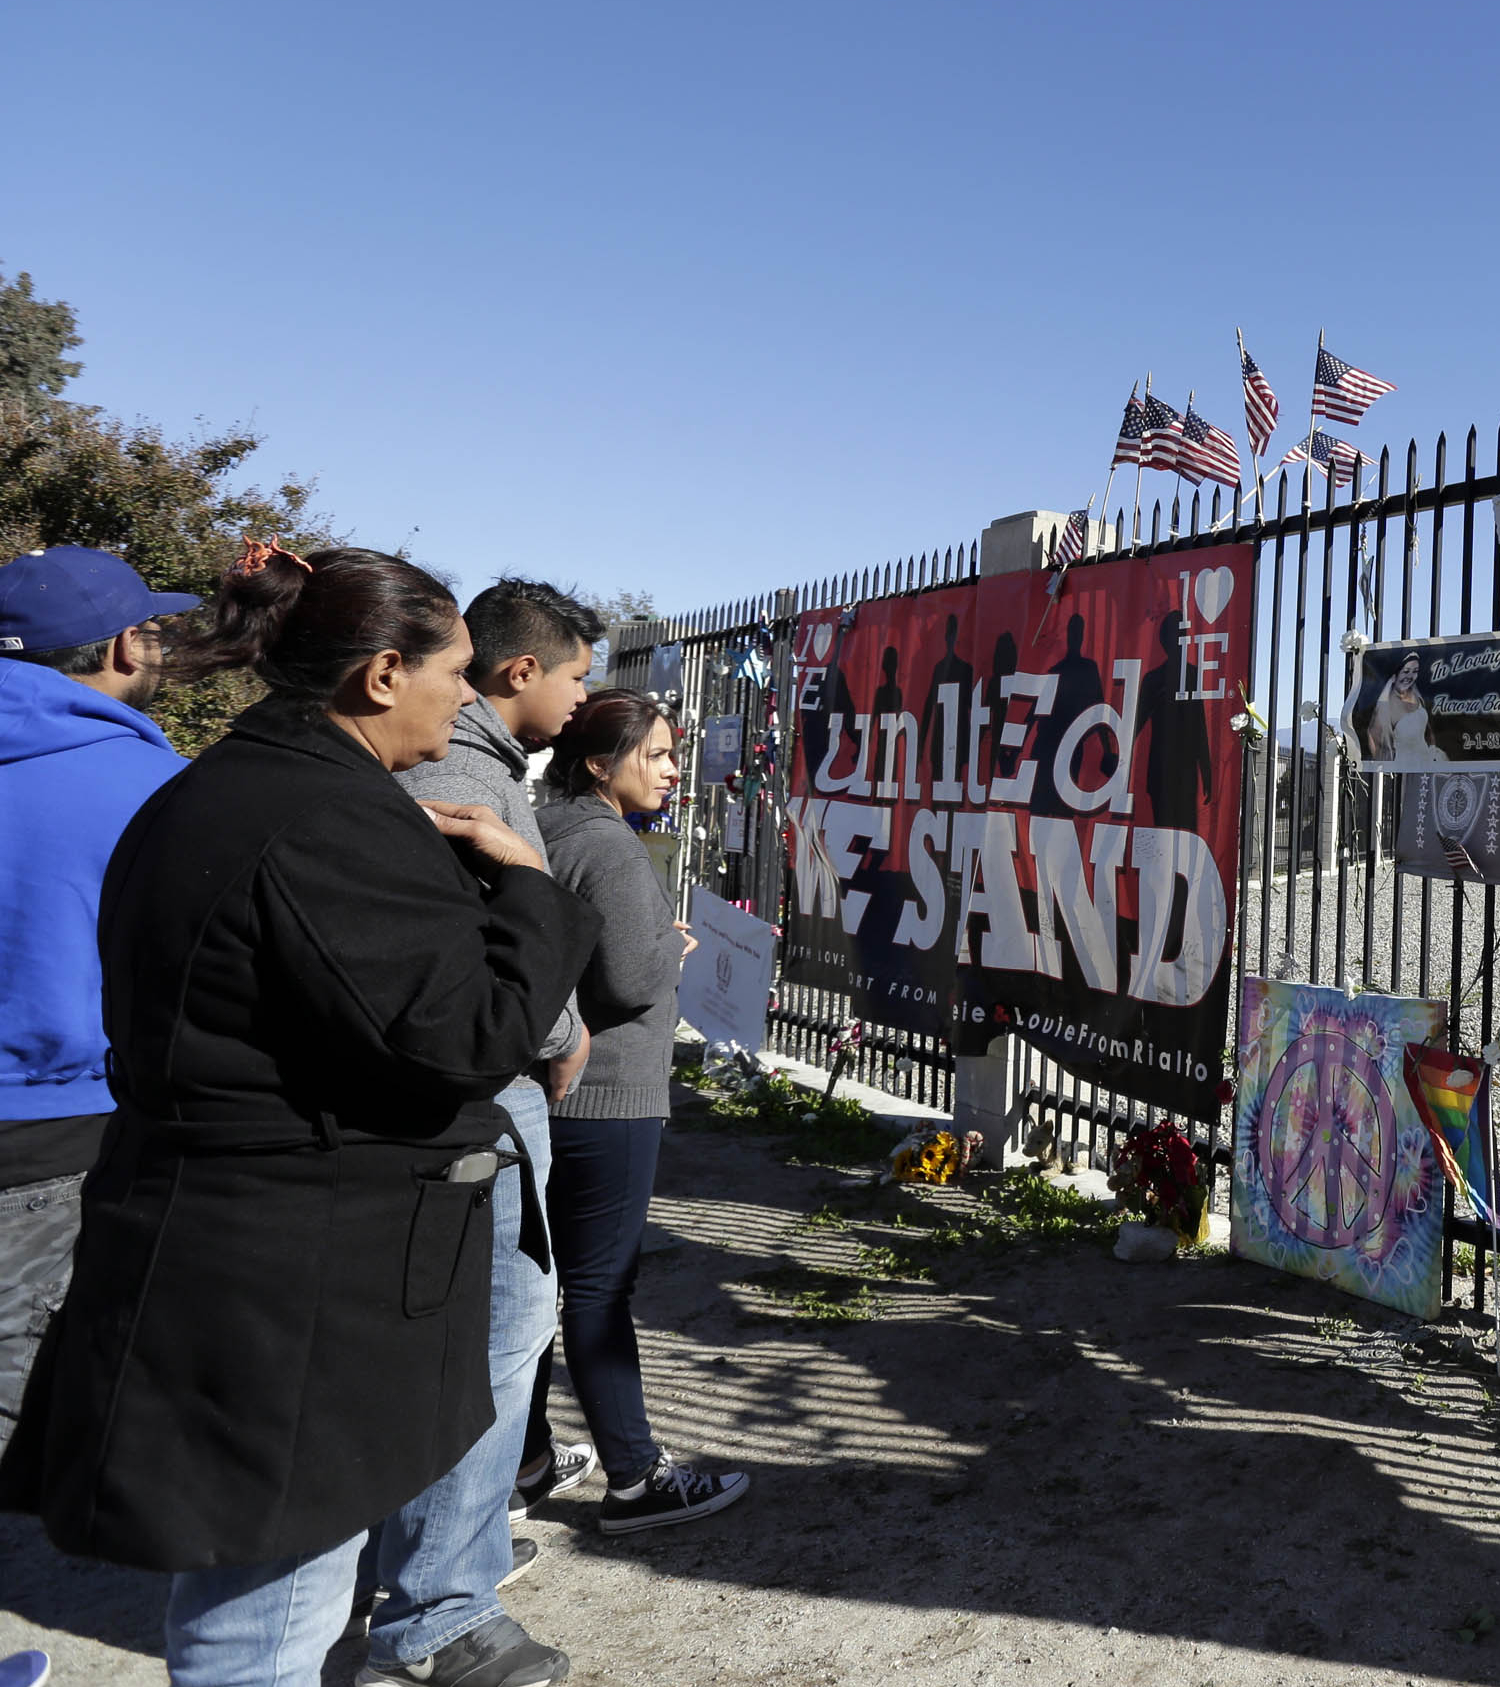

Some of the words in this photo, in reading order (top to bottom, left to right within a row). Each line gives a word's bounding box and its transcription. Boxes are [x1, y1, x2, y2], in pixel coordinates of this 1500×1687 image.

[1179, 570, 1191, 630] I
[1175, 632, 1229, 700] IE
[1431, 659, 1448, 682] In
[1432, 694, 1480, 714] Aurora
[787, 797, 891, 935] WE
[892, 808, 1227, 1006] STAND
[818, 950, 845, 967] LOVE
[888, 982, 937, 1005] FROM
